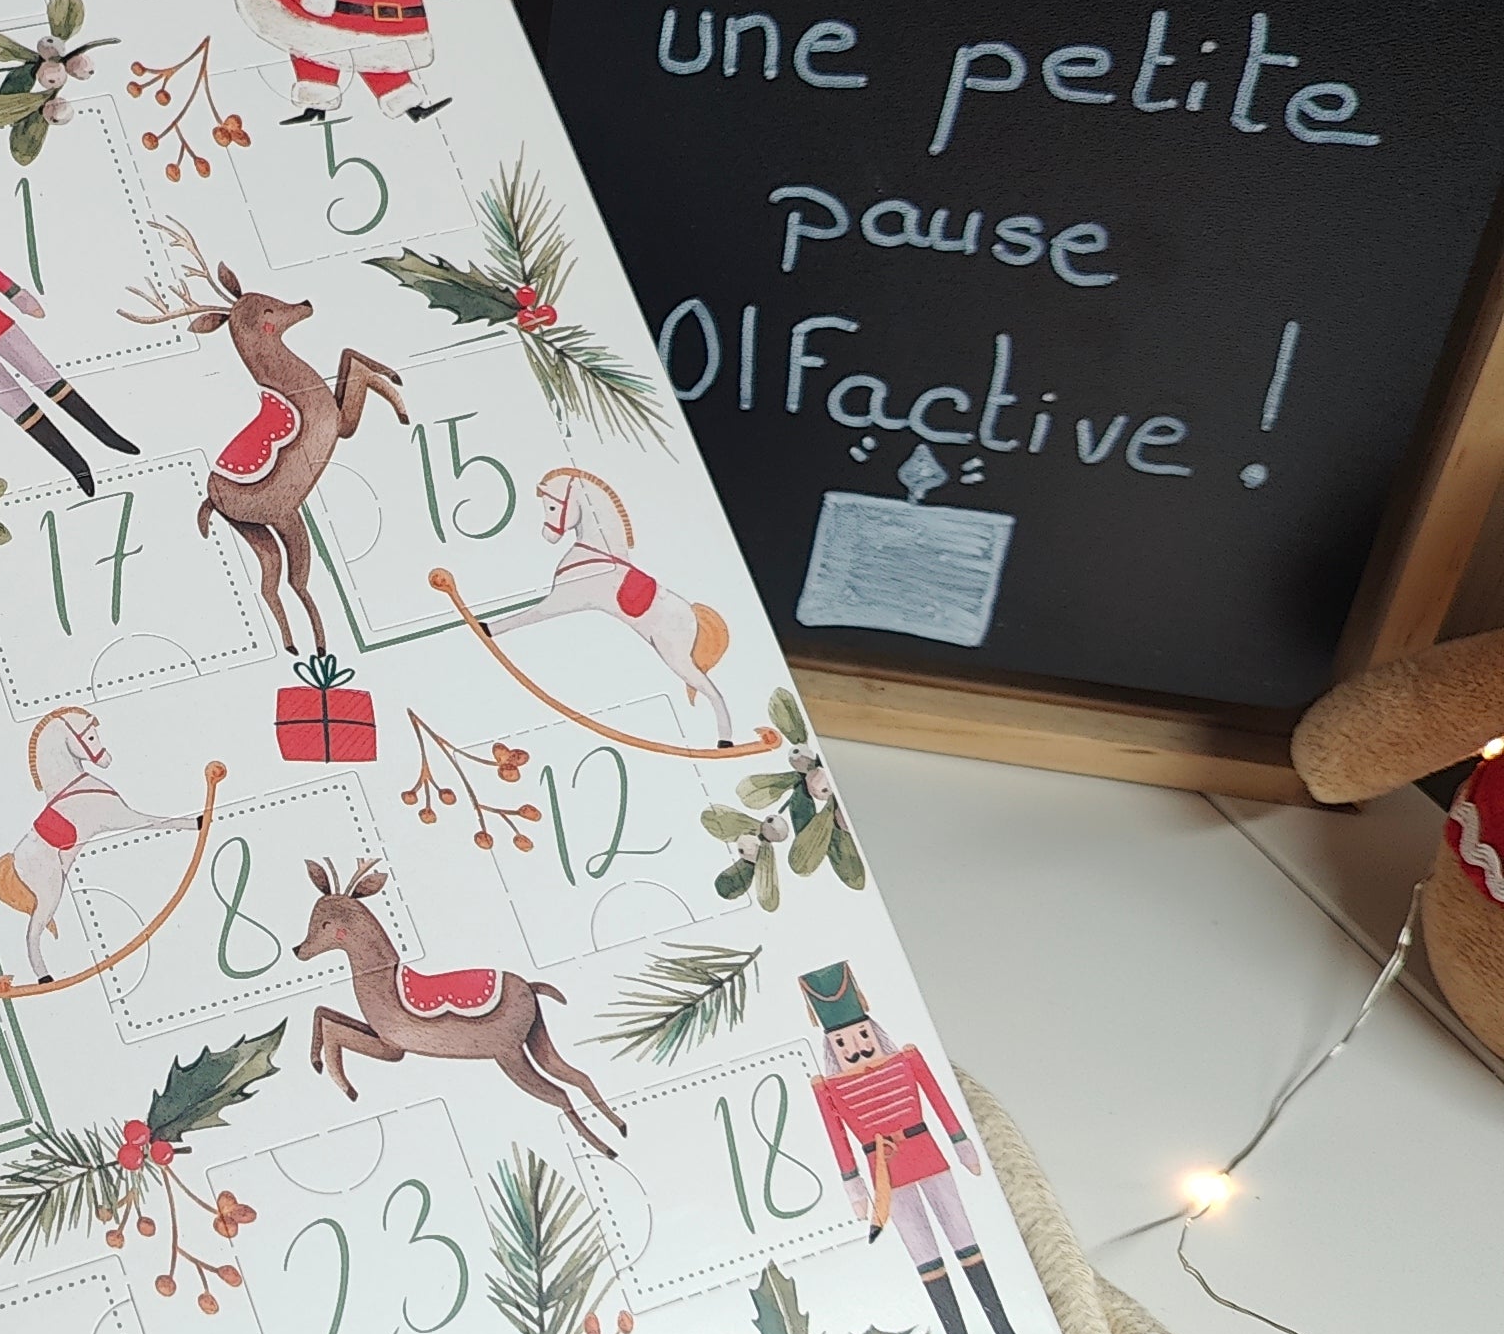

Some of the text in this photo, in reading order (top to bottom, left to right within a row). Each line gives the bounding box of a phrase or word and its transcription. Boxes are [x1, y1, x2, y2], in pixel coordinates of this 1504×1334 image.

[657, 8, 1382, 155] une petite
[14, 177, 45, 295] 1
[309, 116, 389, 237] 5
[768, 185, 1117, 286] pause
[1238, 320, 1299, 489] !
[410, 410, 518, 545] 15
[40, 491, 144, 637] 17
[540, 746, 673, 887] 12
[210, 837, 282, 980] 8
[713, 1073, 823, 1235] 18
